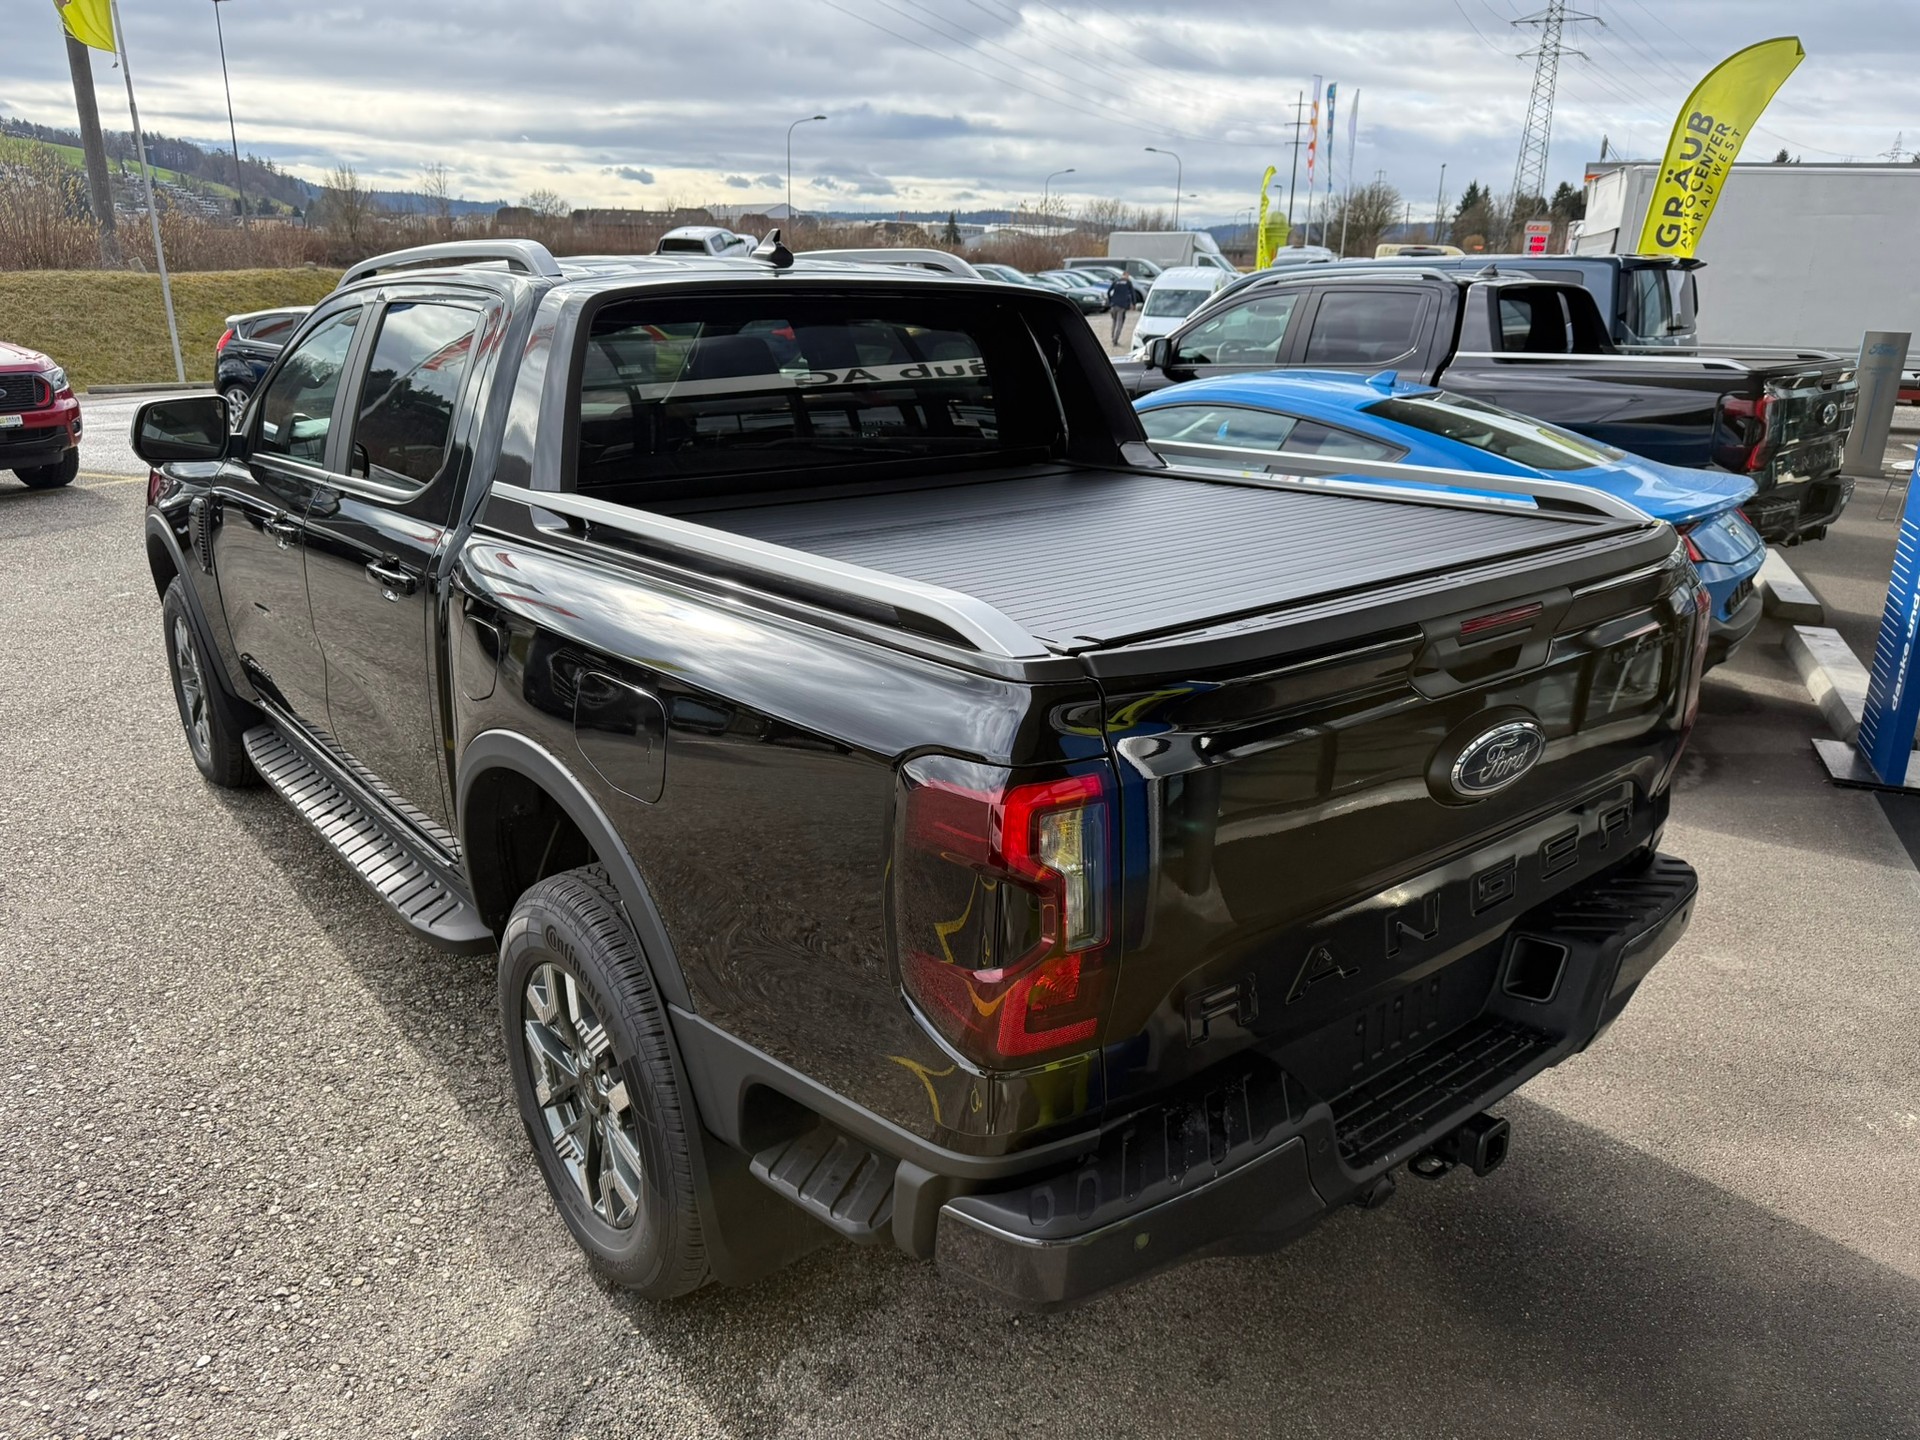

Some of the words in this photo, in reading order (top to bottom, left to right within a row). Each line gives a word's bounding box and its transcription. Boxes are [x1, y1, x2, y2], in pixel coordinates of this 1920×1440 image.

[1655, 111, 1714, 248] GRÄUB
[1687, 185, 1713, 247] ARAU
[1712, 128, 1741, 176] WEST
[1891, 642, 1910, 712] danke
[1907, 592, 1920, 639] und
[1478, 736, 1531, 784] Ford
[545, 924, 613, 1027] Continental
[1184, 799, 1634, 1049] RANGER
